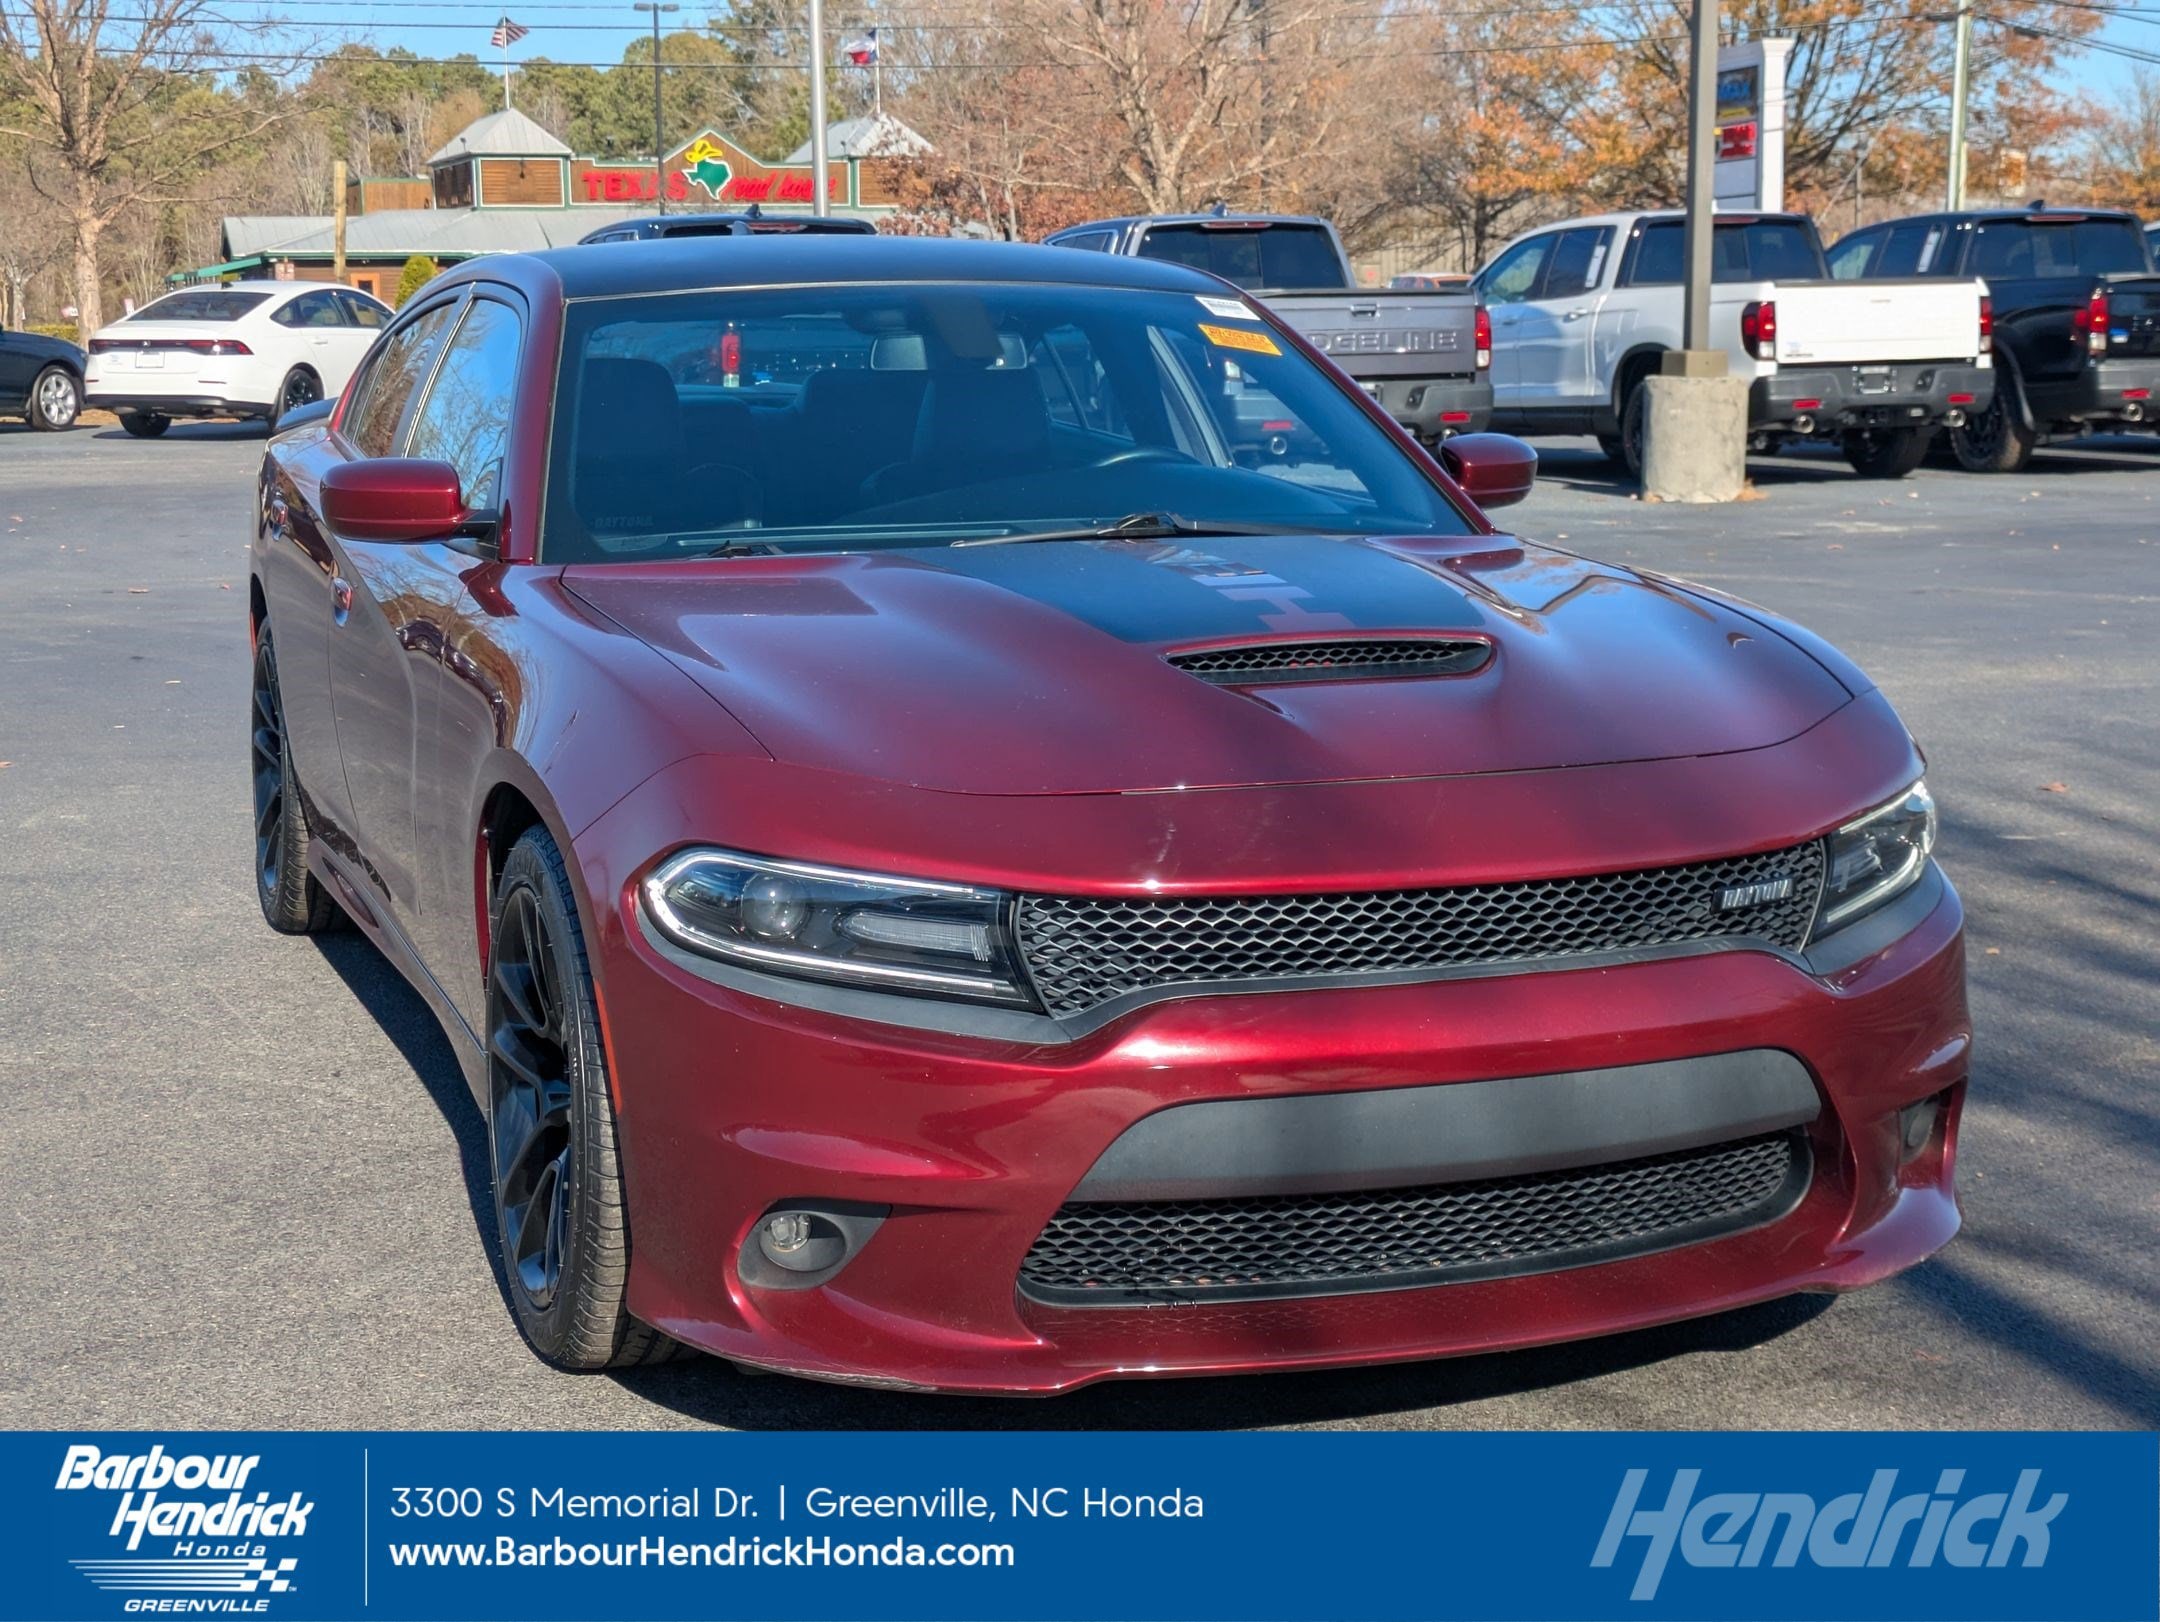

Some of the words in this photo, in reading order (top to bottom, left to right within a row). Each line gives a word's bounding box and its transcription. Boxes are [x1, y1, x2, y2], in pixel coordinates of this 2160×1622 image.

[582, 172, 687, 201] TEXAS
[776, 171, 837, 202] houe
[1308, 331, 1457, 350] DGELINE
